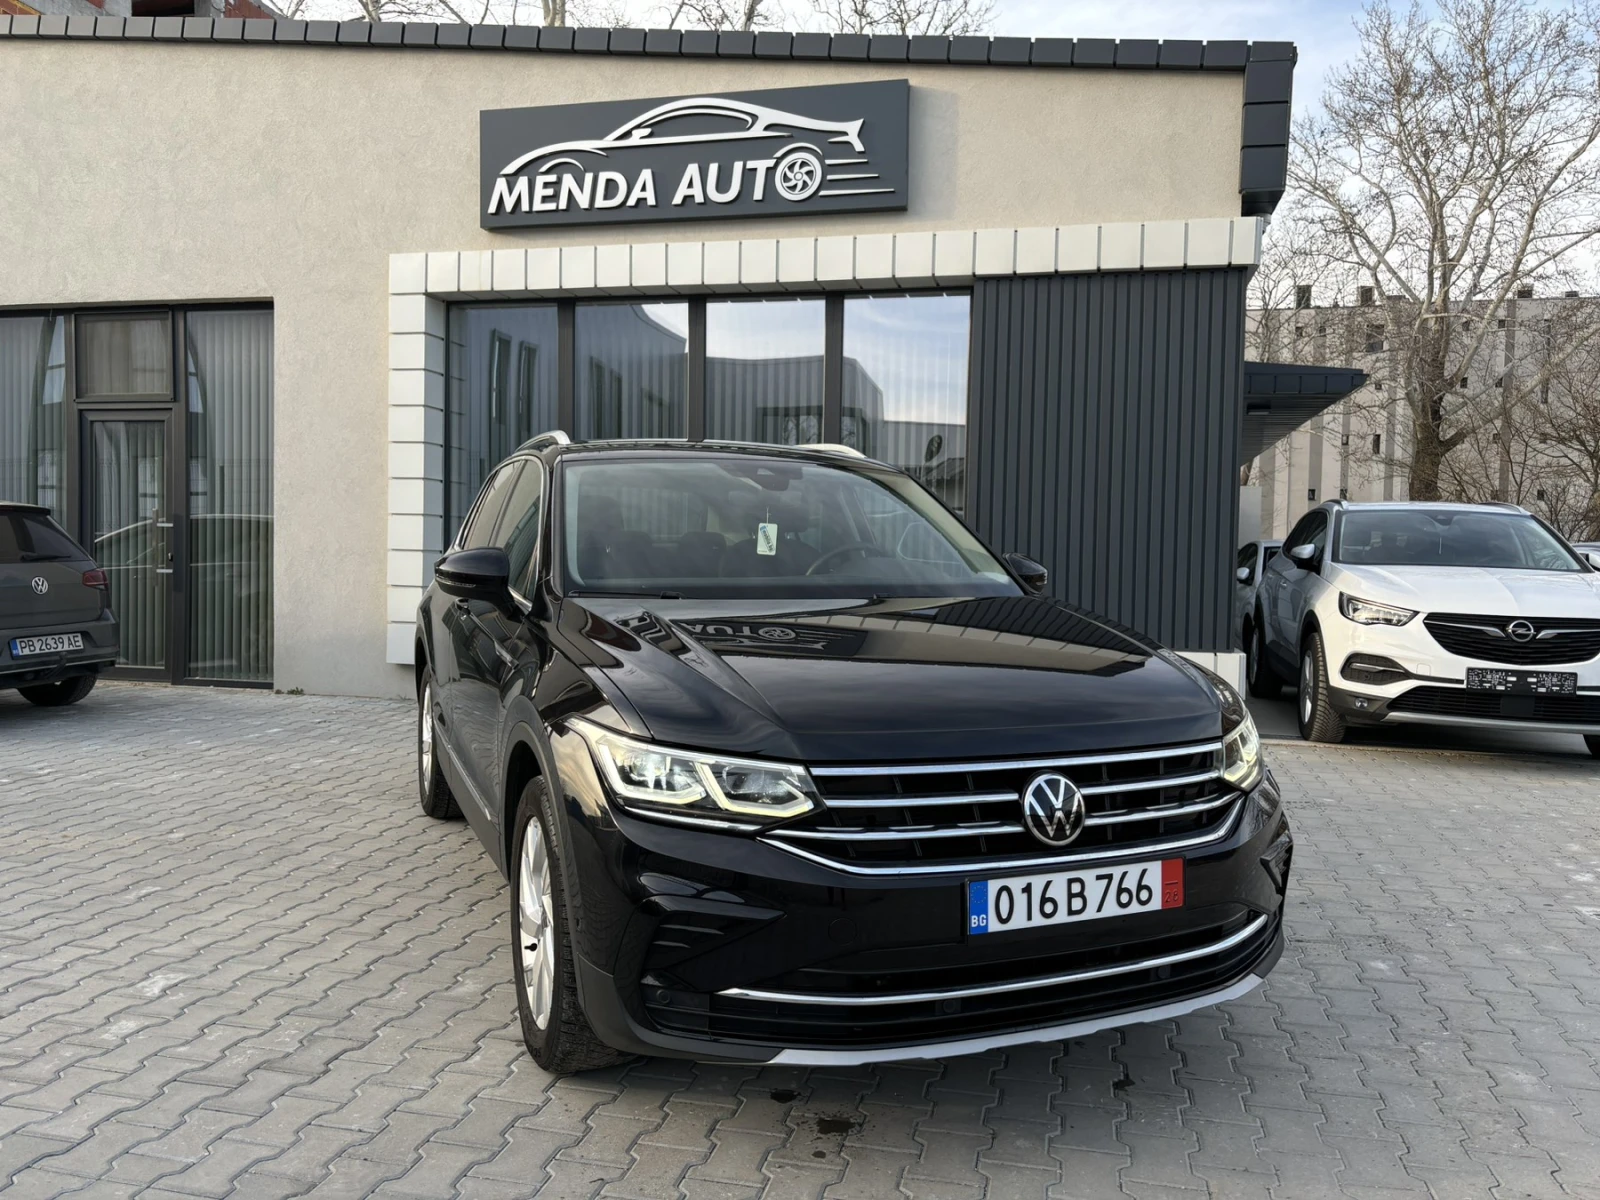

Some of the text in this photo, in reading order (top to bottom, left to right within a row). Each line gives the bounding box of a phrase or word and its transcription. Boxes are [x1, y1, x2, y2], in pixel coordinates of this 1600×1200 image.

[488, 168, 657, 214] MENDA
[37, 637, 65, 652] 2639
[971, 914, 987, 928] BG
